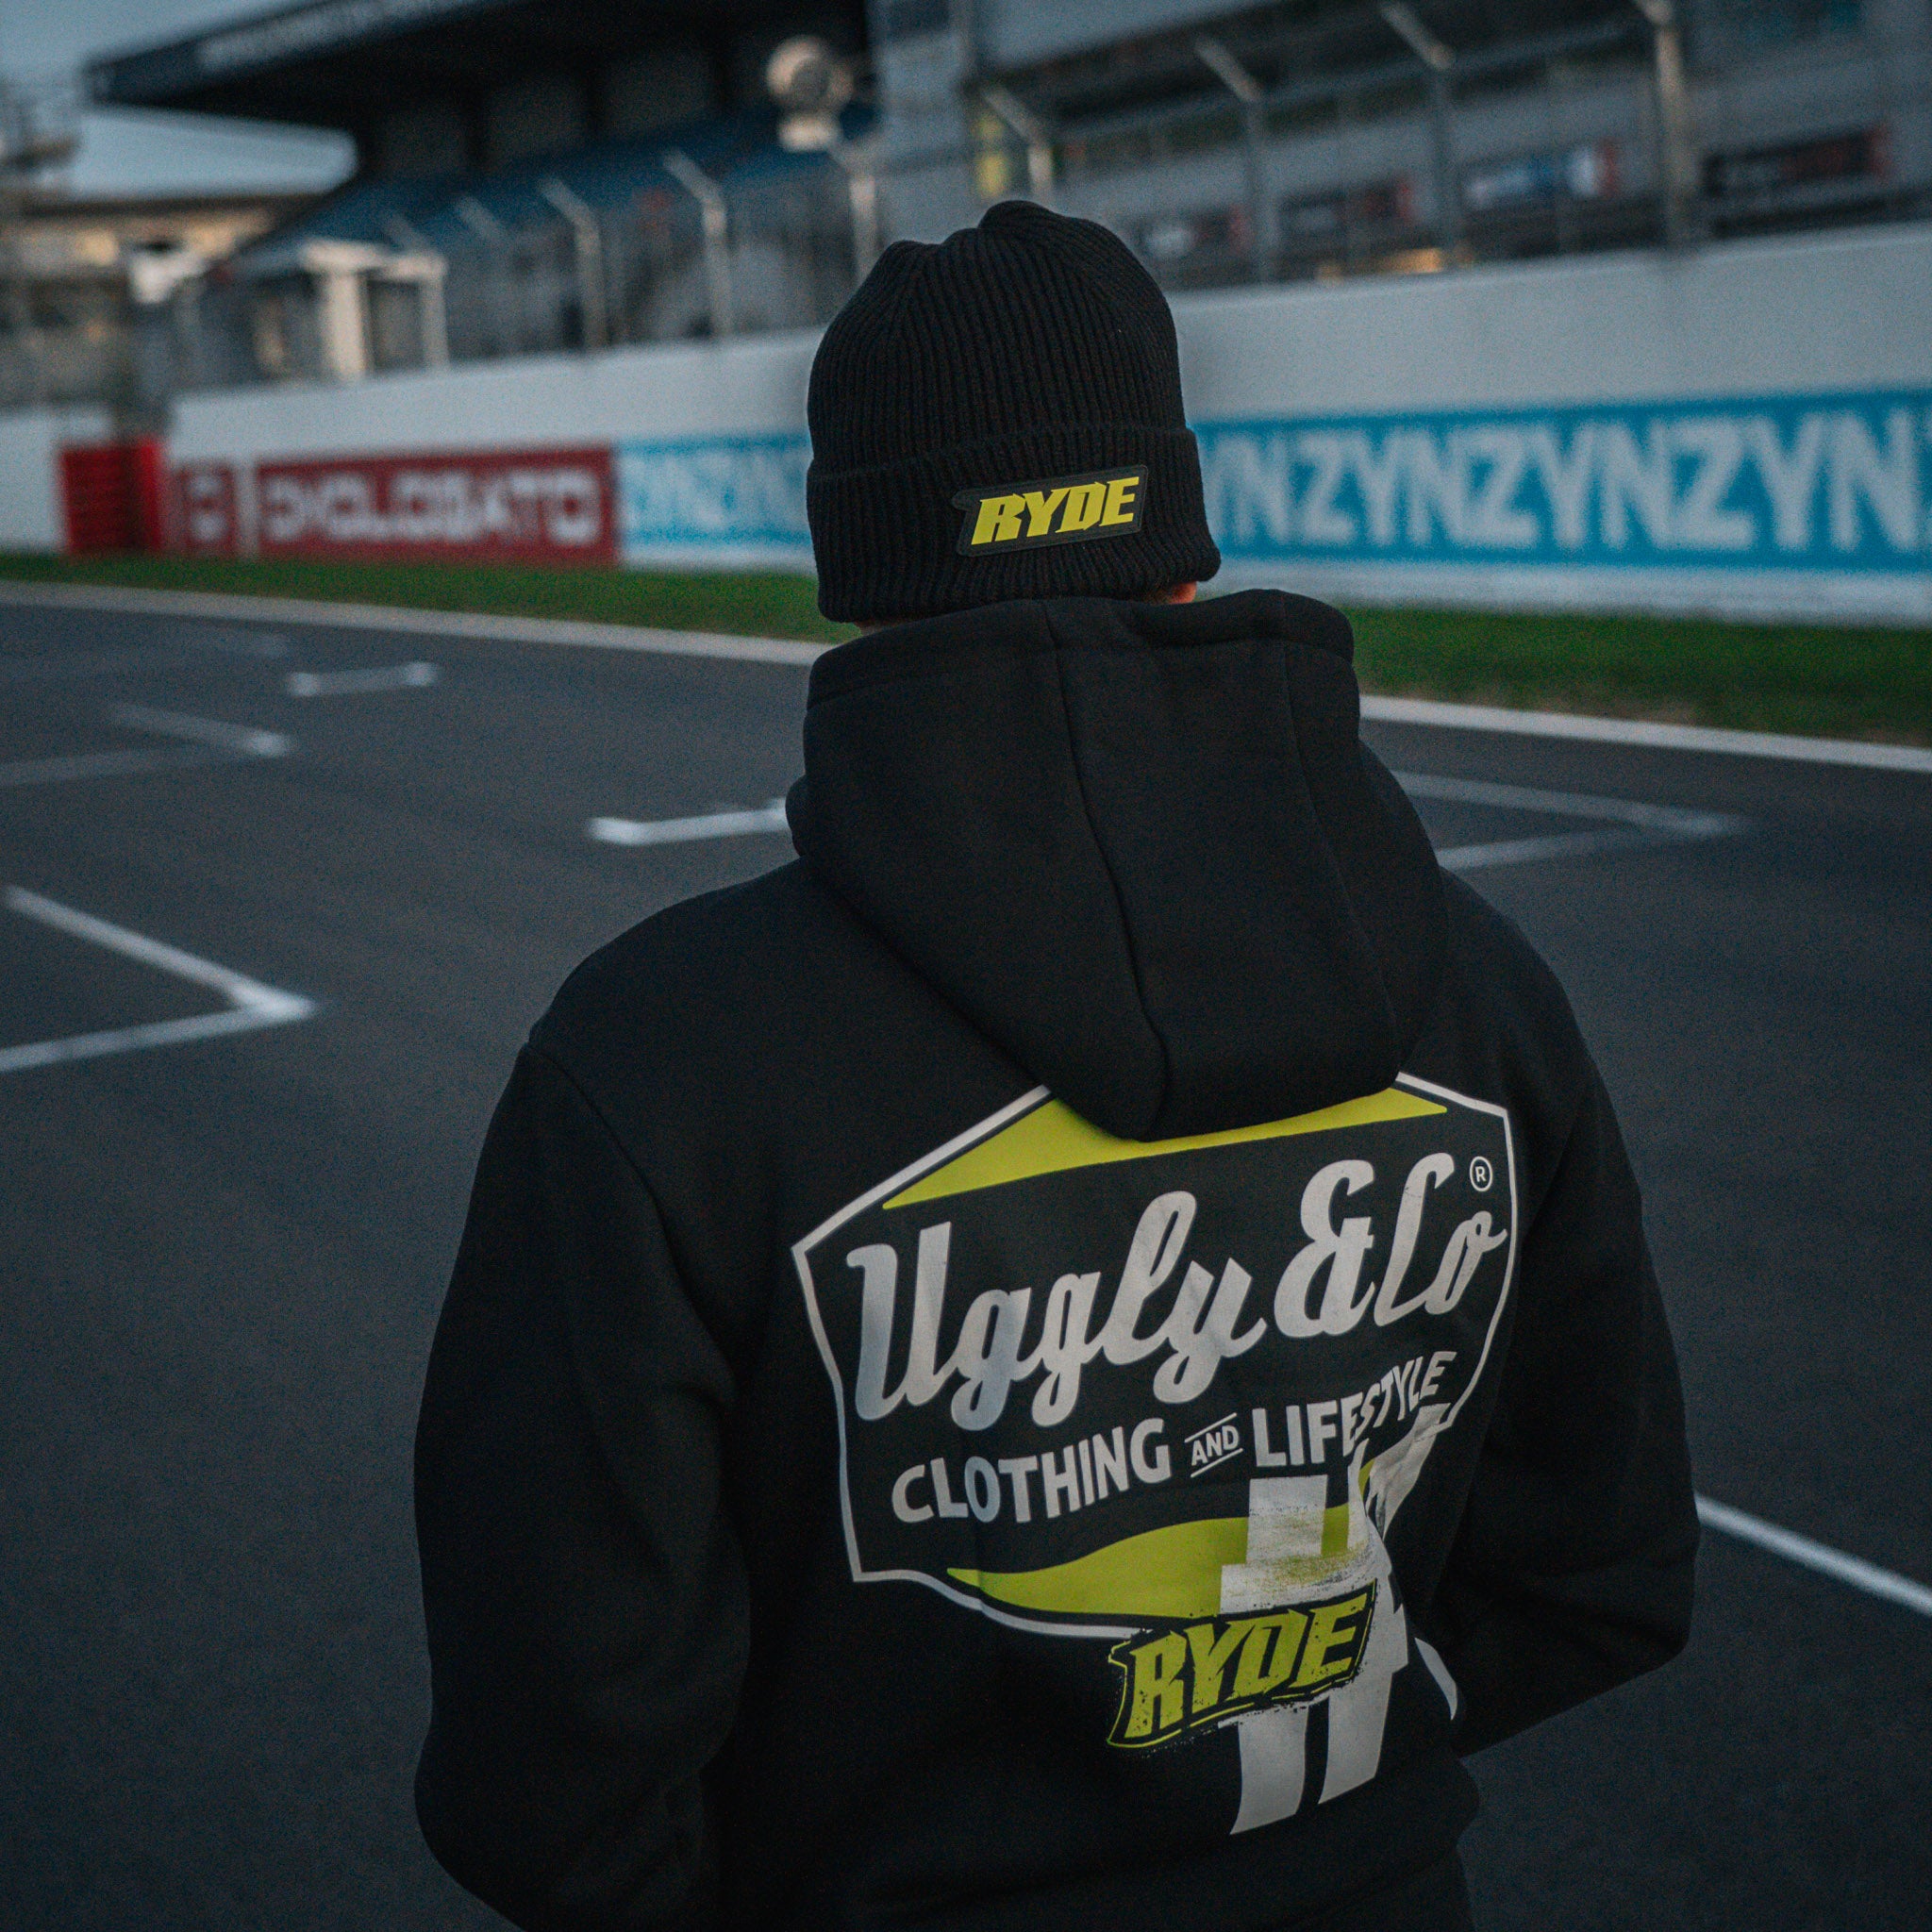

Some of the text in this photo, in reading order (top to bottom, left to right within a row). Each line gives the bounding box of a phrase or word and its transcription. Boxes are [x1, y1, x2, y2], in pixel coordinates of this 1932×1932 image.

[971, 475, 1140, 545] RYDE
[891, 1350, 1458, 1524] CLOTHING AND LIFESTYLE
[1124, 1592, 1369, 1740] RYDE
